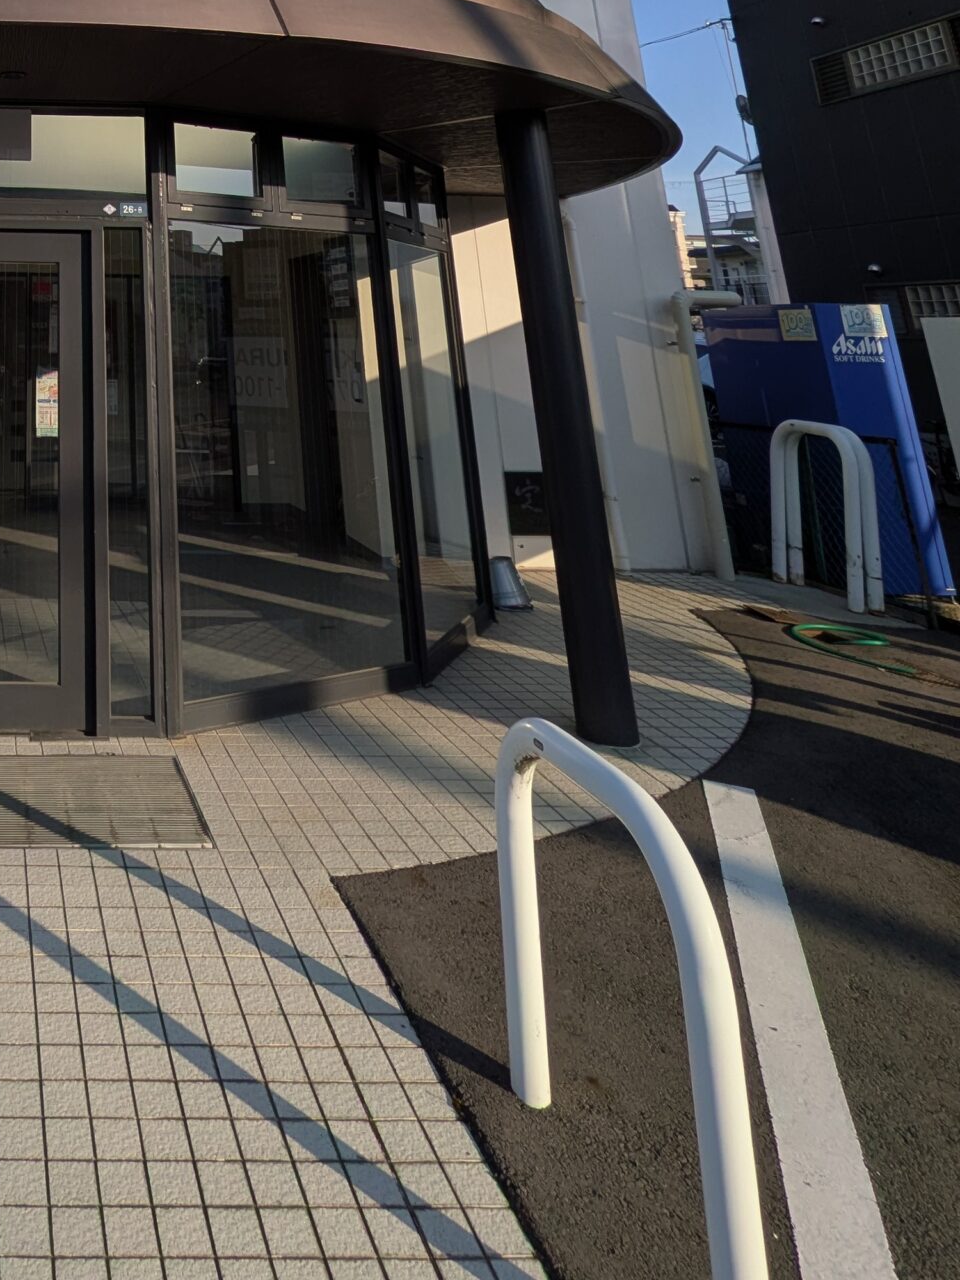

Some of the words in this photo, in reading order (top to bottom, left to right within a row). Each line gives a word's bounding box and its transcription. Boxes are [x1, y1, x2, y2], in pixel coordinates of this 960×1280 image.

[831, 333, 884, 355] Asahi
[833, 354, 854, 362] SOFT
[855, 355, 885, 363] DRINKS
